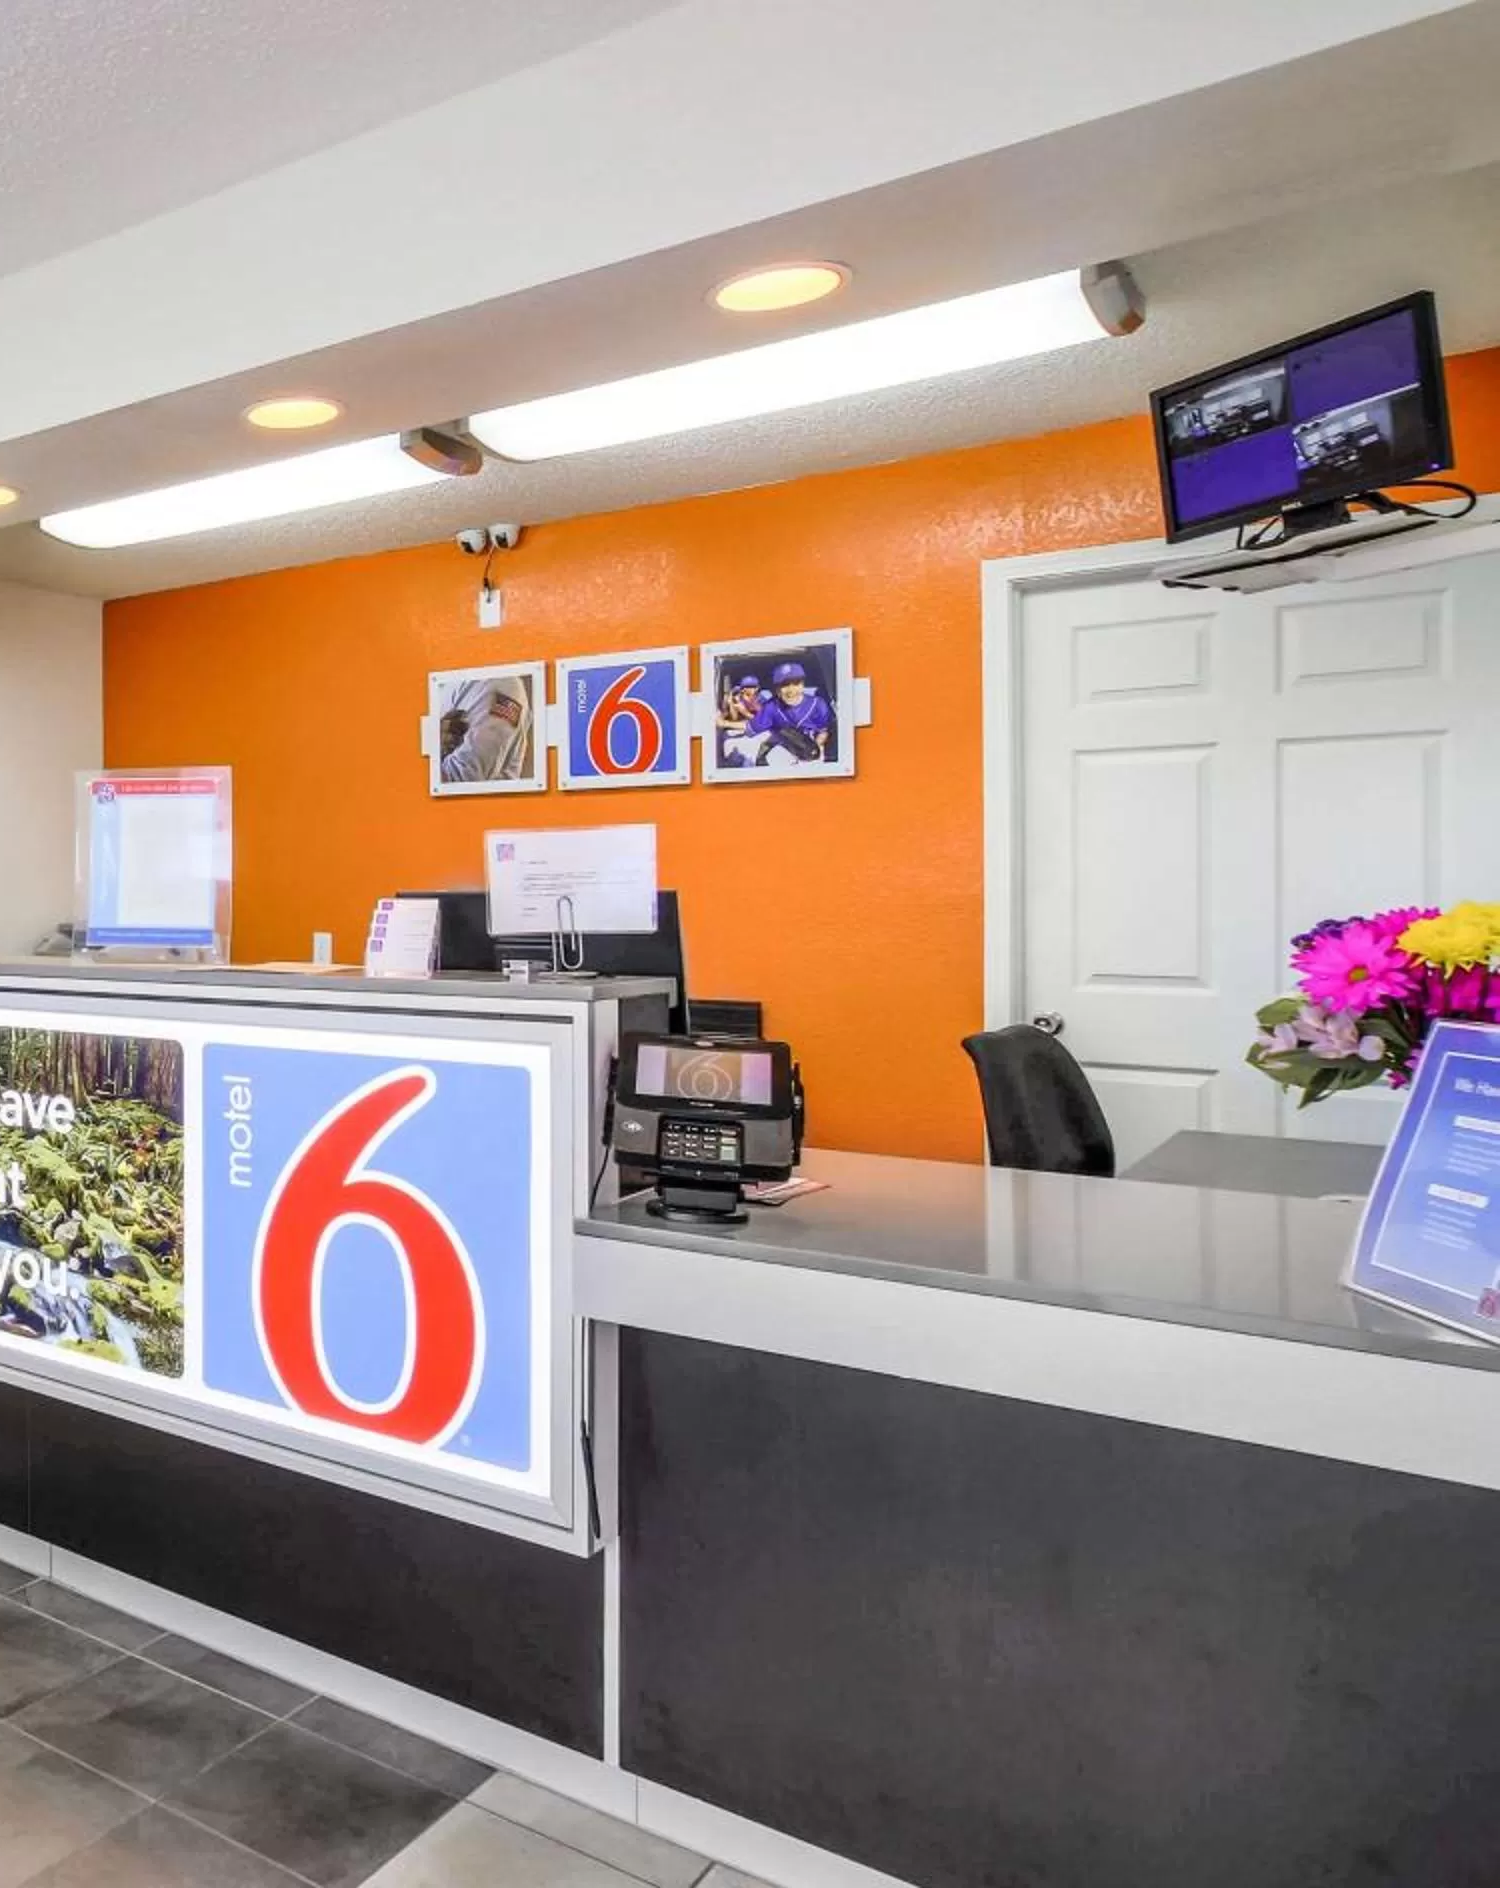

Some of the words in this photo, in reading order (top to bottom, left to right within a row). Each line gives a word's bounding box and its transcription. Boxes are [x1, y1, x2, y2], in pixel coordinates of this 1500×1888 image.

[586, 665, 663, 776] 6
[224, 1074, 252, 1188] motel
[252, 1065, 487, 1452] 6
